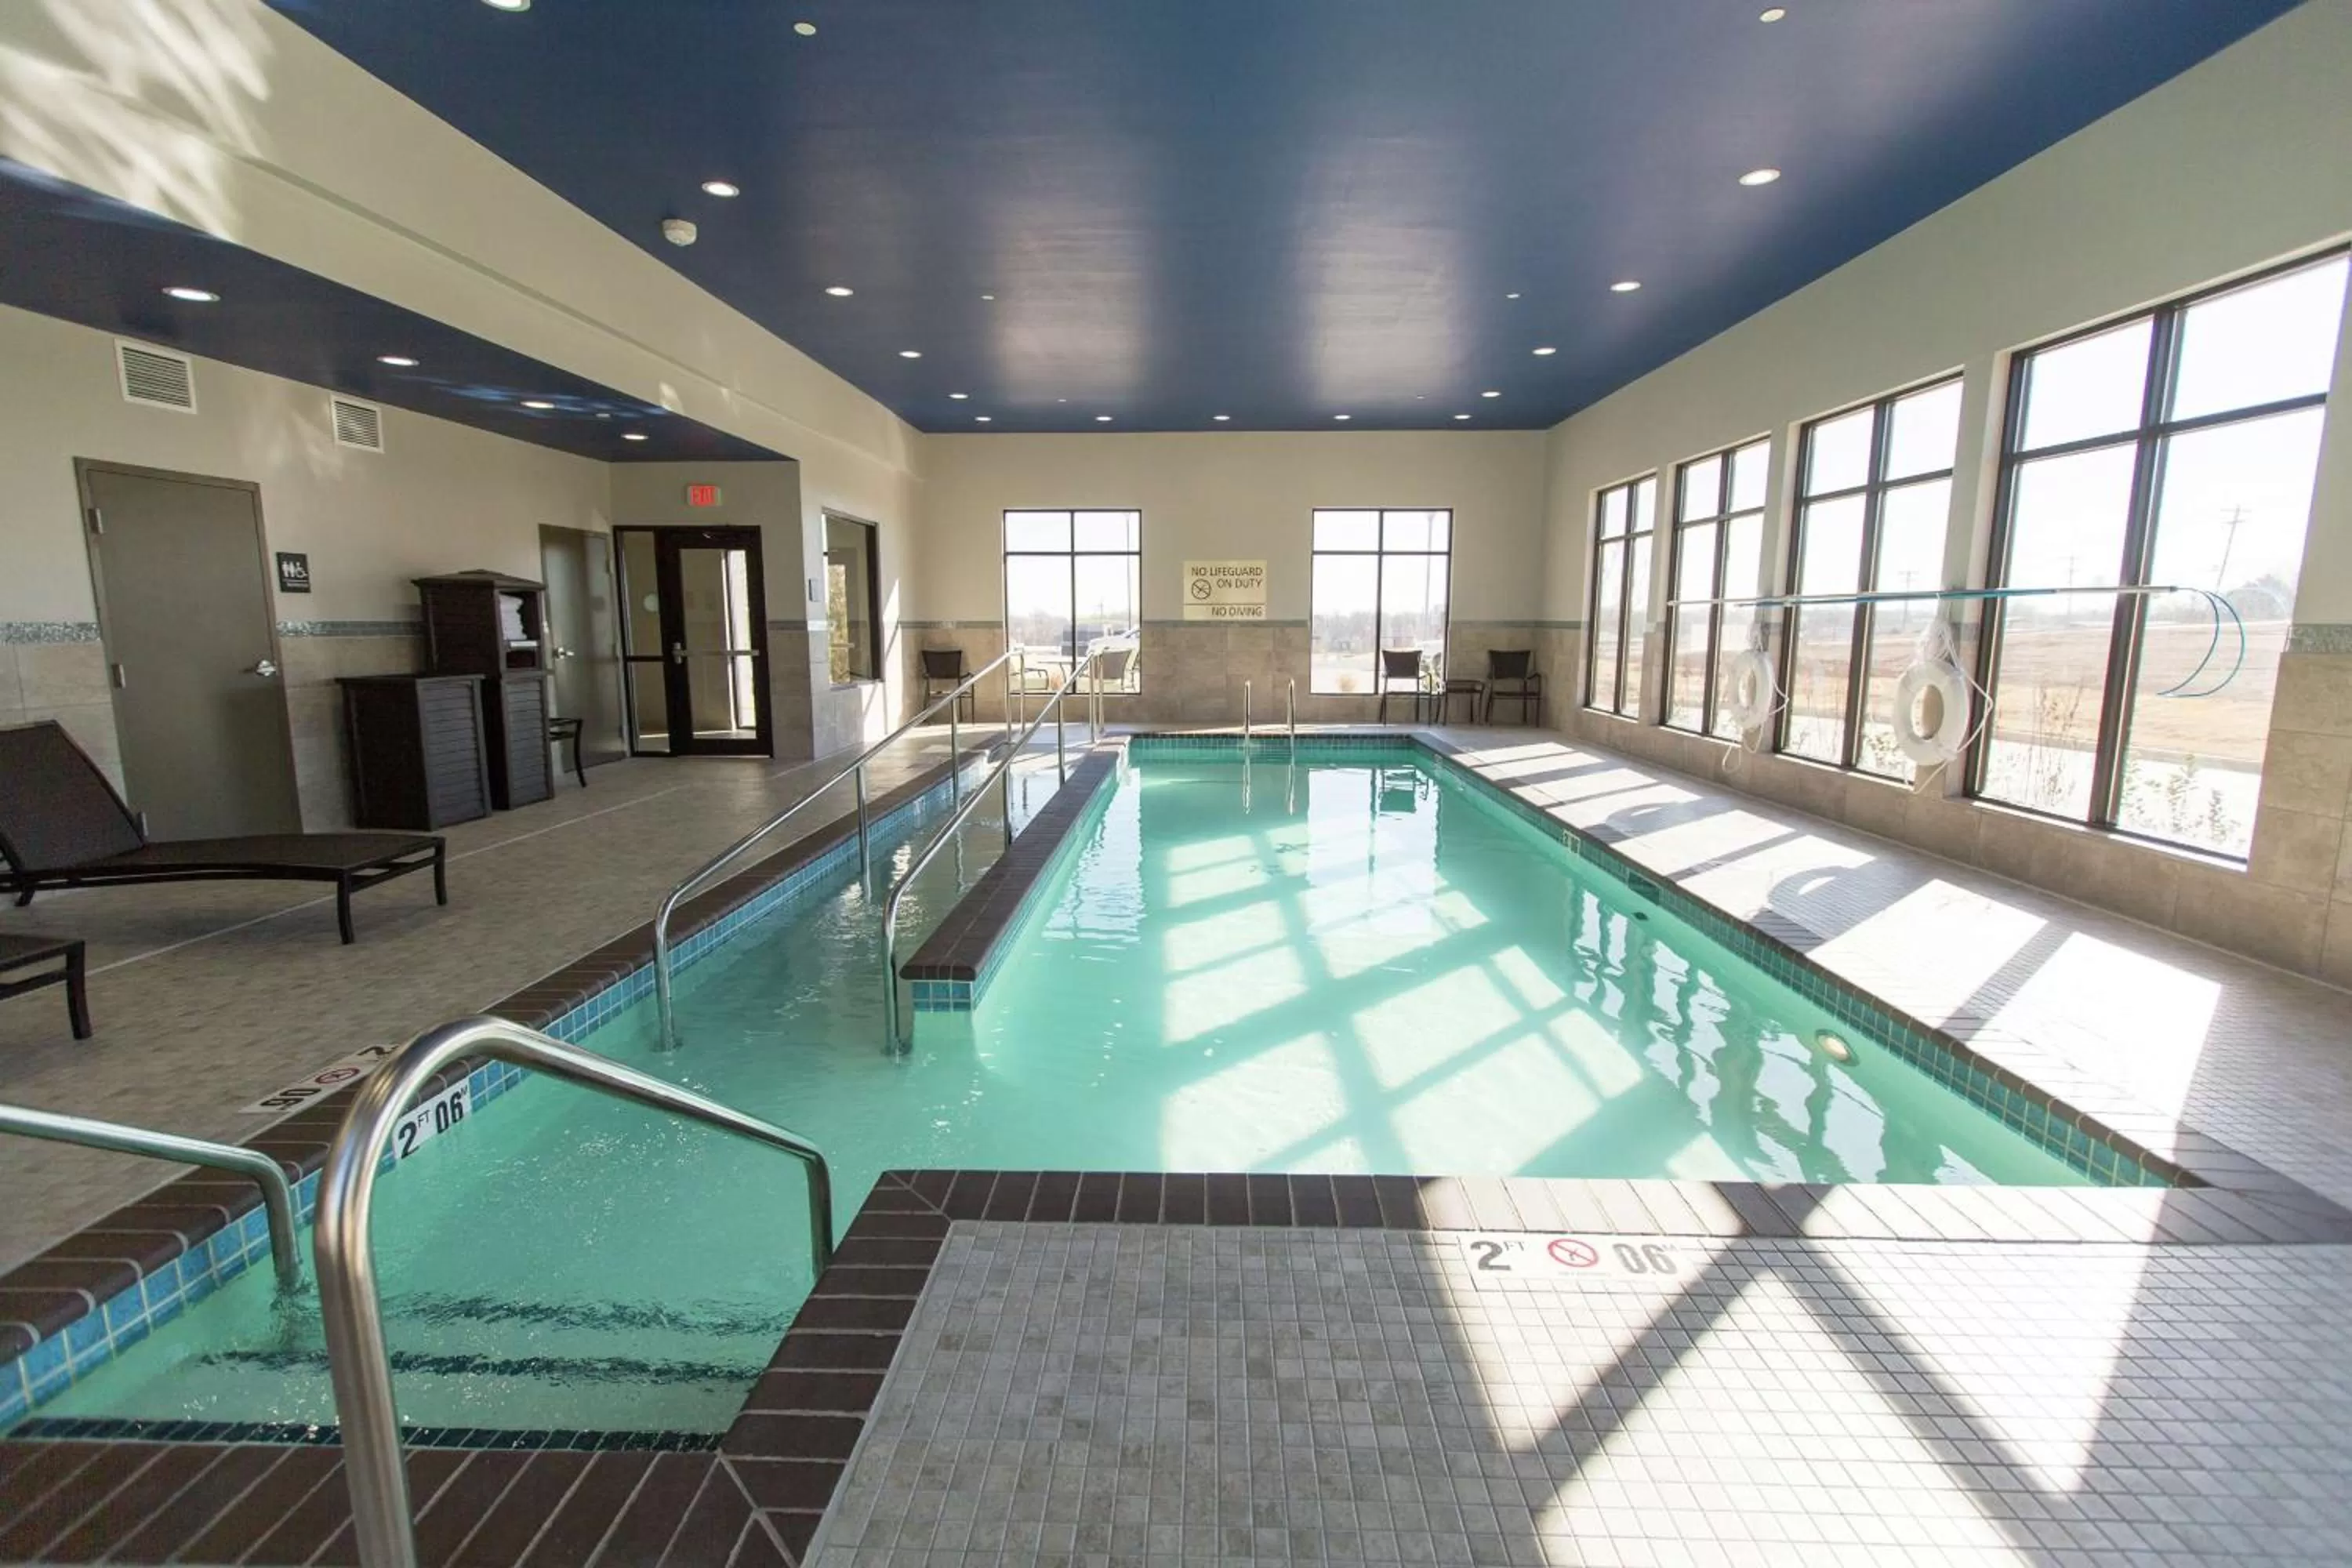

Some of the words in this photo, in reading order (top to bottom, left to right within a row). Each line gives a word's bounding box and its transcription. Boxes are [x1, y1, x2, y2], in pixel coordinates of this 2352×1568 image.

[1191, 567, 1207, 576] NO
[1210, 567, 1263, 576] LIFEGUARD
[1217, 579, 1232, 589] ON
[1235, 579, 1261, 588] DUTY
[1211, 607, 1227, 616] NO
[1229, 607, 1262, 617] DIVING
